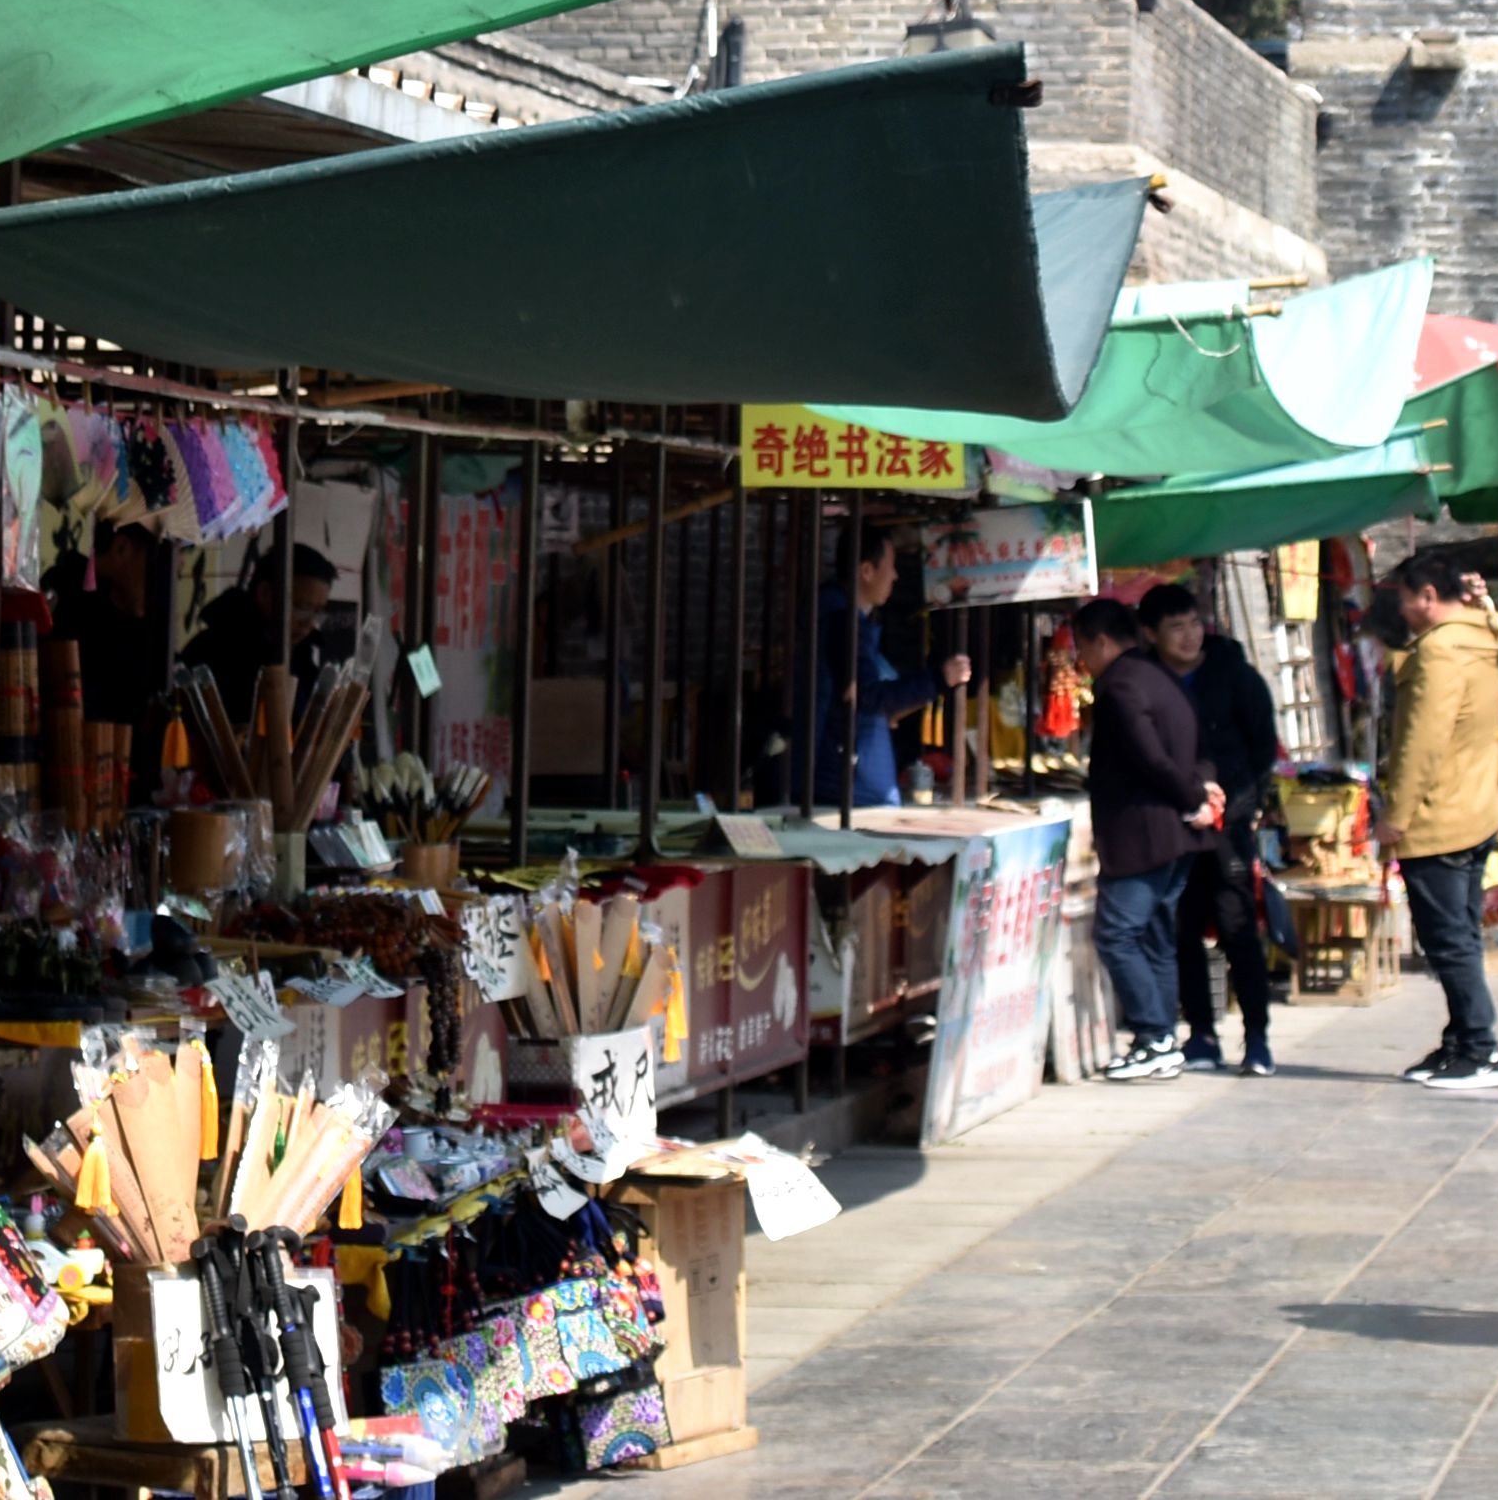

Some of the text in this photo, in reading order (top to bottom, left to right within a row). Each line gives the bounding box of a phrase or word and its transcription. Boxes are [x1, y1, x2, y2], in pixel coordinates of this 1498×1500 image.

[752, 422, 954, 479] 奇绝书法家
[589, 1048, 655, 1118] 戒尺
